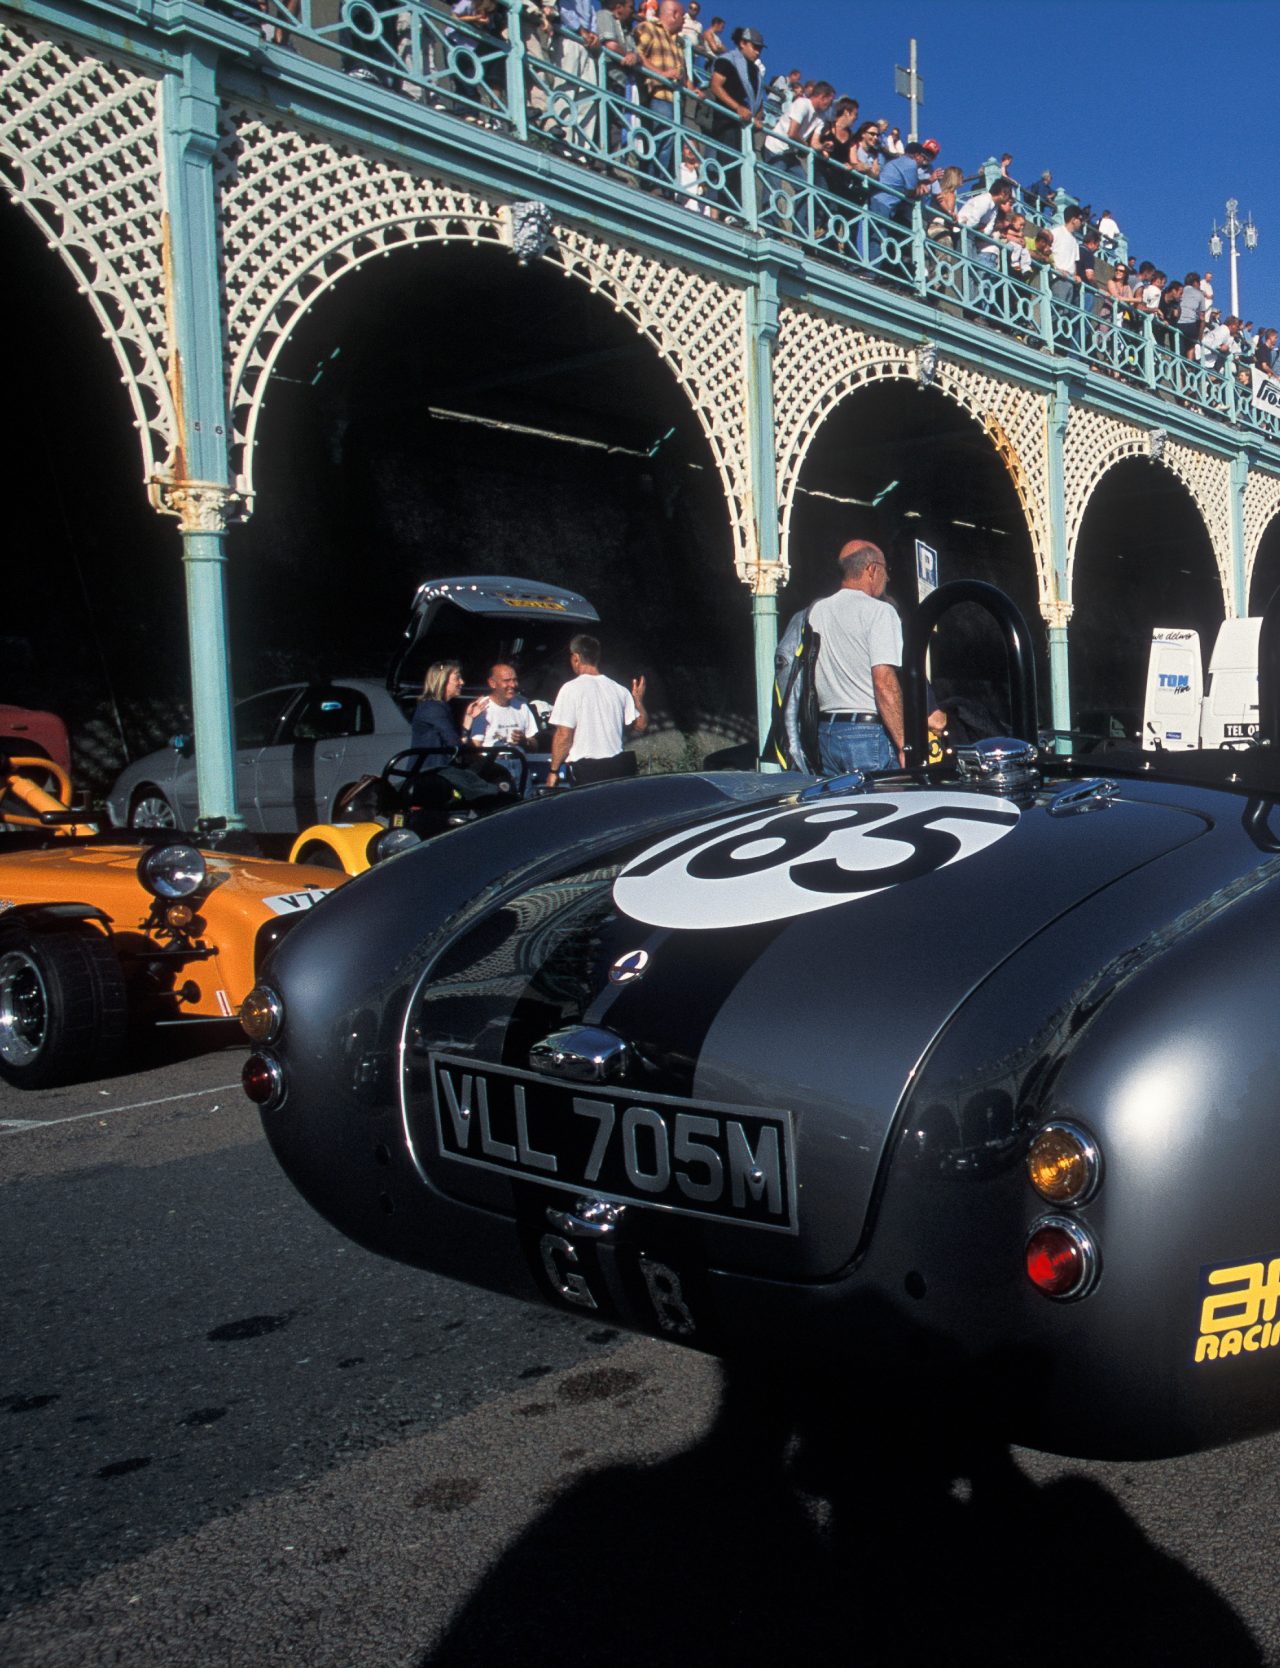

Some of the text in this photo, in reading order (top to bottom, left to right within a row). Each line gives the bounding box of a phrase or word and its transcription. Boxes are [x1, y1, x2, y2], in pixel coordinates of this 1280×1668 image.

[920, 546, 934, 580] P
[1226, 725, 1244, 736] TEL
[618, 802, 1020, 894] 185
[439, 1069, 783, 1215] VLL 705M
